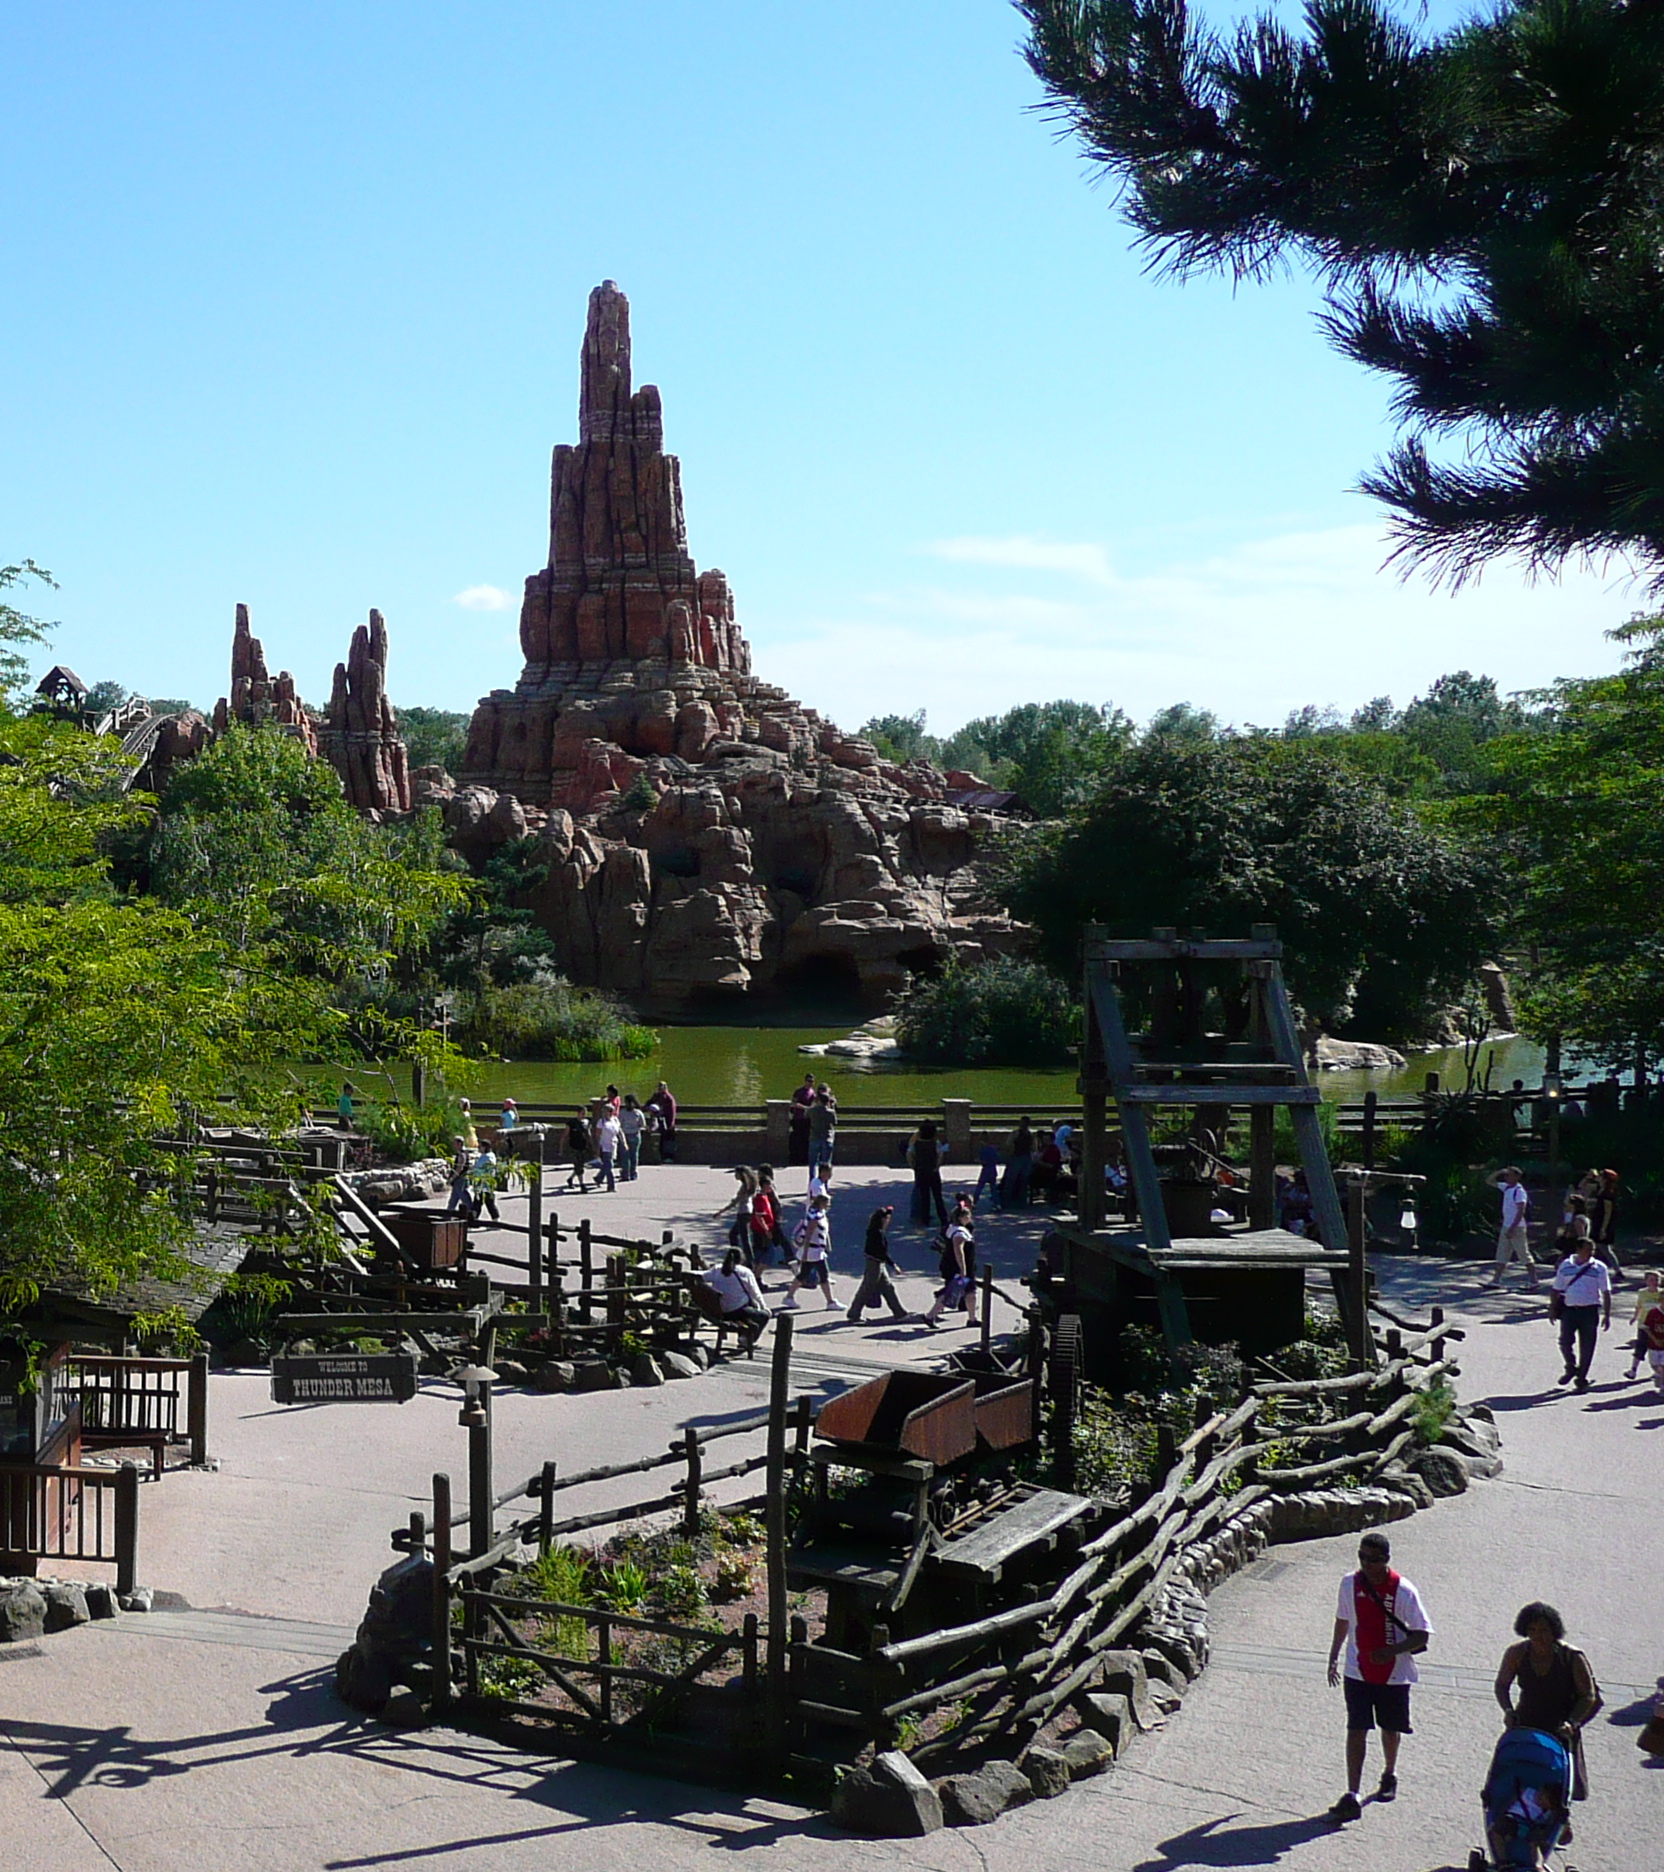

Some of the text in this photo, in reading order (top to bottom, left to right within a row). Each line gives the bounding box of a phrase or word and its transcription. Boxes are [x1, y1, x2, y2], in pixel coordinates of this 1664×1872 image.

[318, 1361, 368, 1373] WELCOME TO
[293, 1377, 394, 1397] THUNDER MESA
